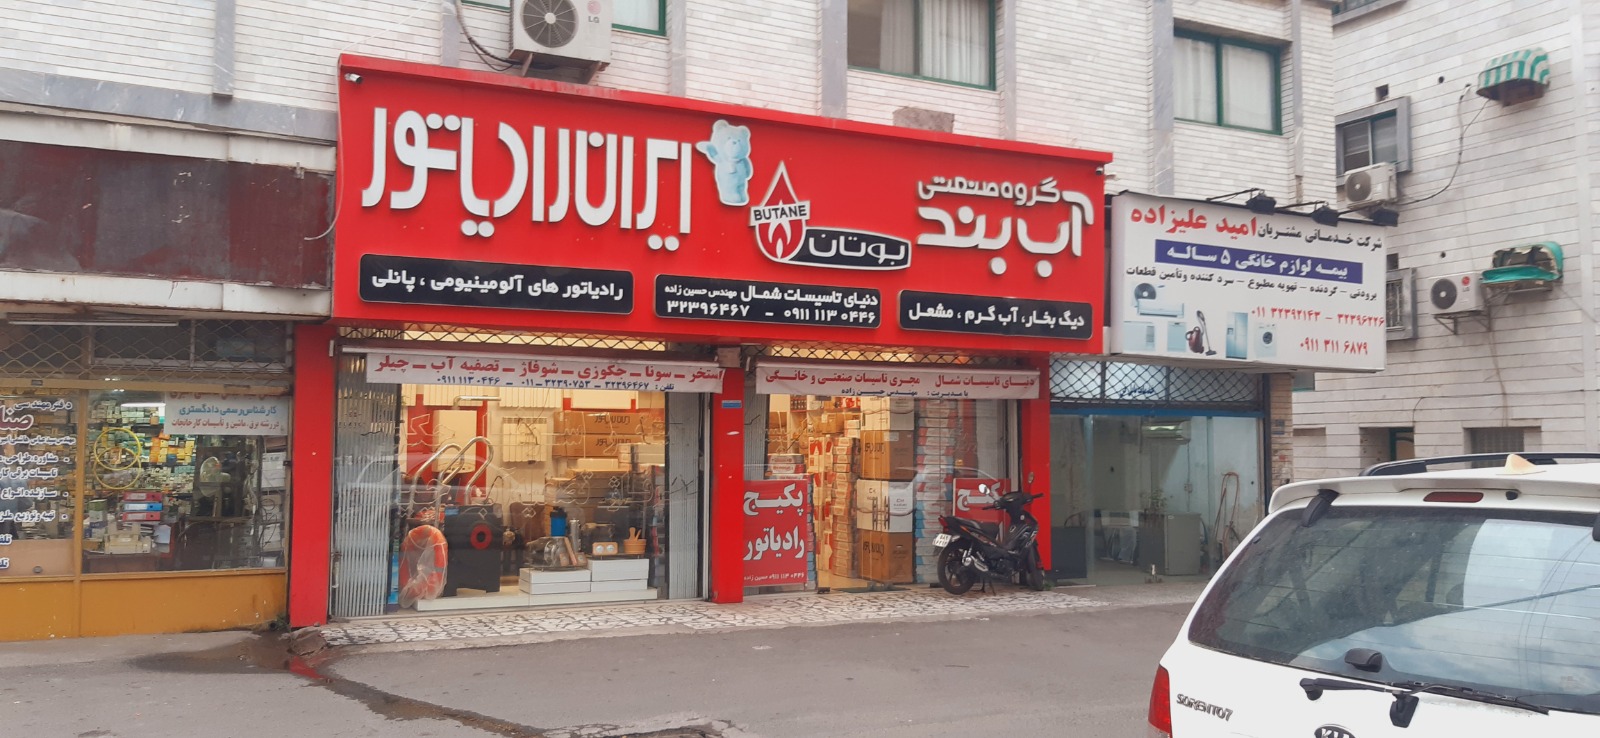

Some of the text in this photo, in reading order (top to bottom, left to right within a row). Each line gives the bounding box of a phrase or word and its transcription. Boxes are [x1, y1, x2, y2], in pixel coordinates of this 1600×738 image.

[362, 107, 692, 251] ایران رادیاتور
[917, 176, 1060, 207] گروه صنعتی
[753, 204, 807, 221] BUTANE
[916, 190, 1094, 278] آب بند
[1131, 204, 1383, 252] شرکت خدماتی مشتریان امید علیزاده
[808, 233, 906, 265] بوتان
[1126, 264, 1157, 277] قطعات
[1167, 244, 1348, 281] بیمه لوازم خانگی ۵ ساله
[371, 268, 624, 301] رادیاتور های آلومینیومی پانلی
[1190, 272, 1214, 283] کننده
[1217, 275, 1235, 286] سرد
[1247, 277, 1275, 290] مطبوع
[1277, 281, 1298, 293] تهویه
[1350, 288, 1378, 302] برودتی
[664, 285, 879, 308] دنیای تاسیسات شمال مهندس حسین زاده
[667, 300, 875, 324] ۳۲۳۹۶۴۶۷ ۰۹۱۱ ۱۱۳ ۰۴۴۶
[908, 302, 954, 321] مشعل
[965, 306, 996, 324] گرم
[998, 306, 1018, 326] آب
[1251, 305, 1265, 318] ۰۱۱
[1058, 311, 1085, 330] دیگ
[1300, 337, 1369, 355] ۰۹۱۱ ۳۱۱ ۶۸۷۹
[374, 354, 724, 383] استخر سونا جکوزی شوفاژ تصفیه آب چیلر
[765, 369, 808, 383] خانگی
[437, 375, 456, 384] ۰۹۱۱
[459, 376, 475, 384] ۱۱۳
[476, 376, 501, 385] ۰۴۴۶
[659, 383, 675, 392] تلفن
[817, 372, 853, 385] صنعتی
[854, 372, 888, 386] تاسیسات
[889, 374, 920, 387] مجری
[935, 374, 962, 388] شمال
[963, 375, 1000, 388] تاسیسات
[1001, 375, 1035, 389] دنیای
[841, 387, 855, 396] زاده
[856, 388, 885, 396] حسین
[887, 388, 918, 396] مهندس
[179, 403, 278, 416] کارشناس رسمی دادگستری
[743, 483, 804, 516] پکیج
[743, 525, 805, 561] رادیاتور
